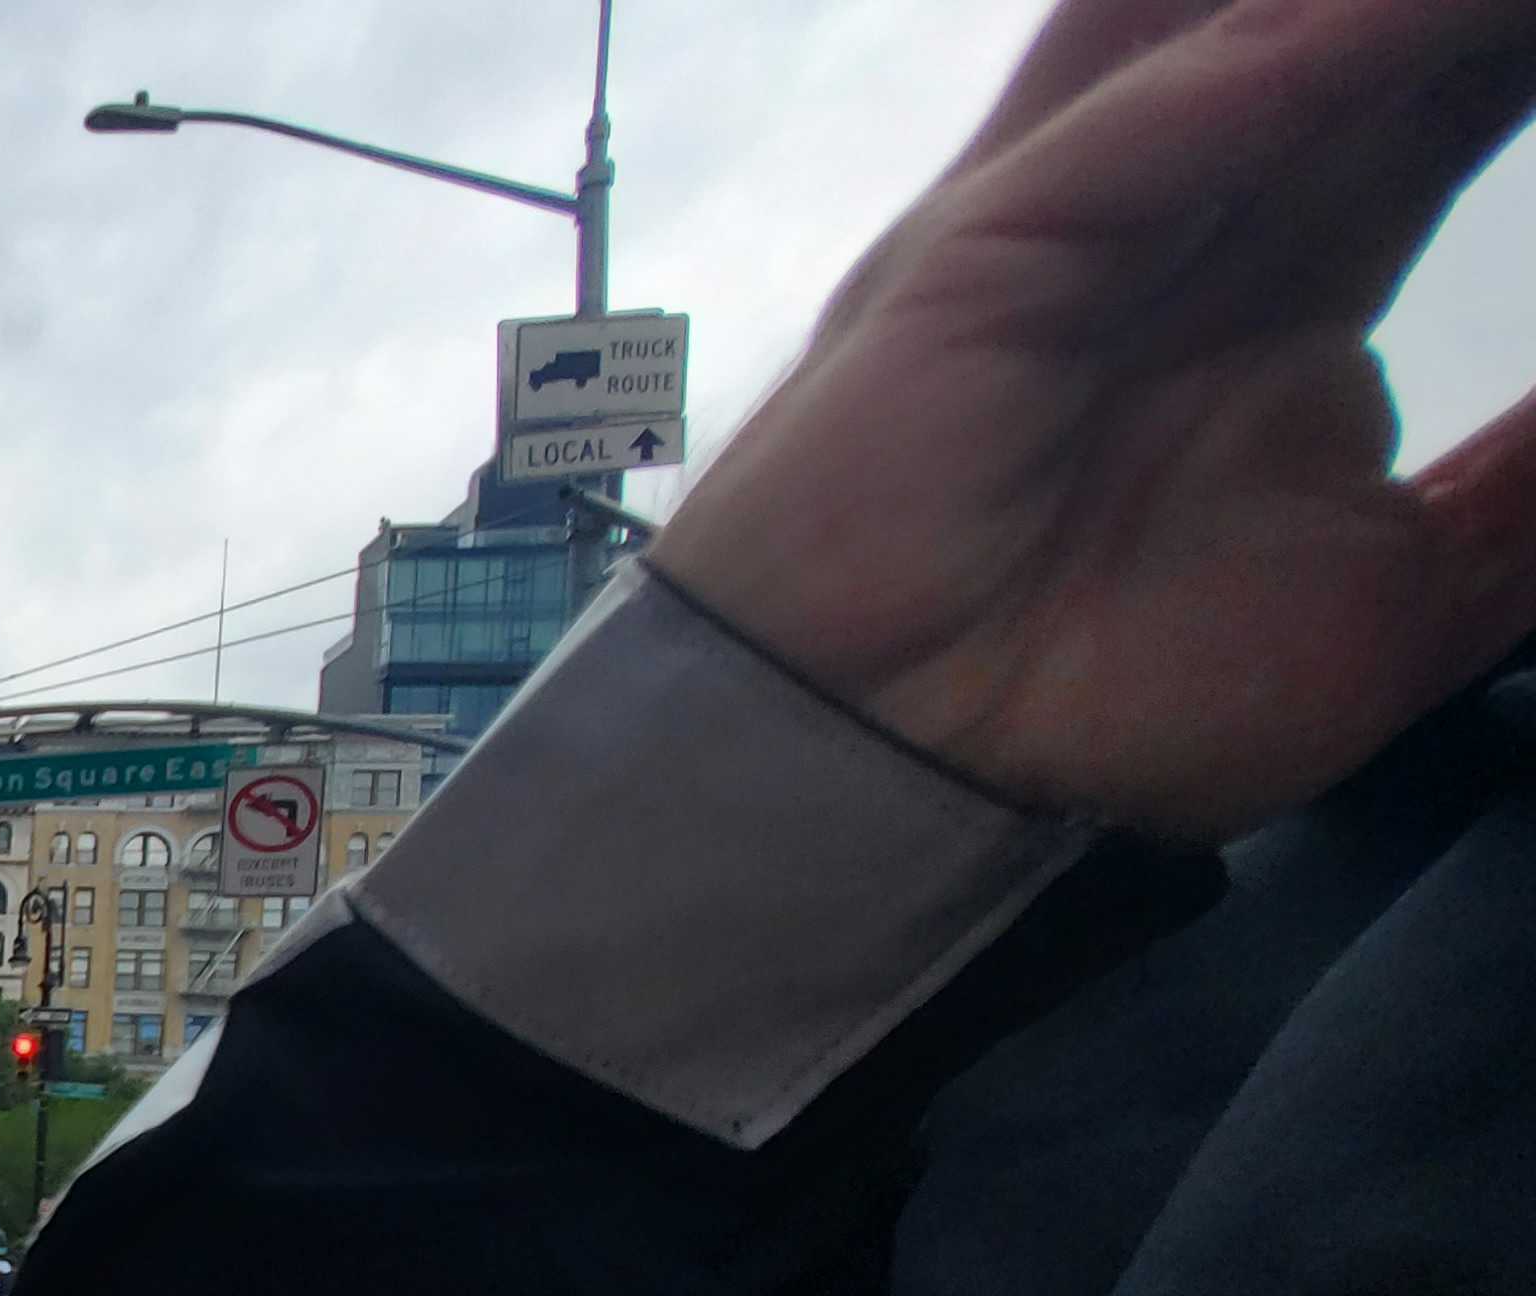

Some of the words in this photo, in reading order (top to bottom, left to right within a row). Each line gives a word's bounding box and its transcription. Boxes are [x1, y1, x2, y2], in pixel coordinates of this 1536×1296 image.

[609, 338, 678, 360] TRUCK
[607, 372, 675, 395] ROUTE
[528, 440, 612, 467] LOCAL
[35, 758, 156, 792] Square
[165, 755, 231, 782] Eas
